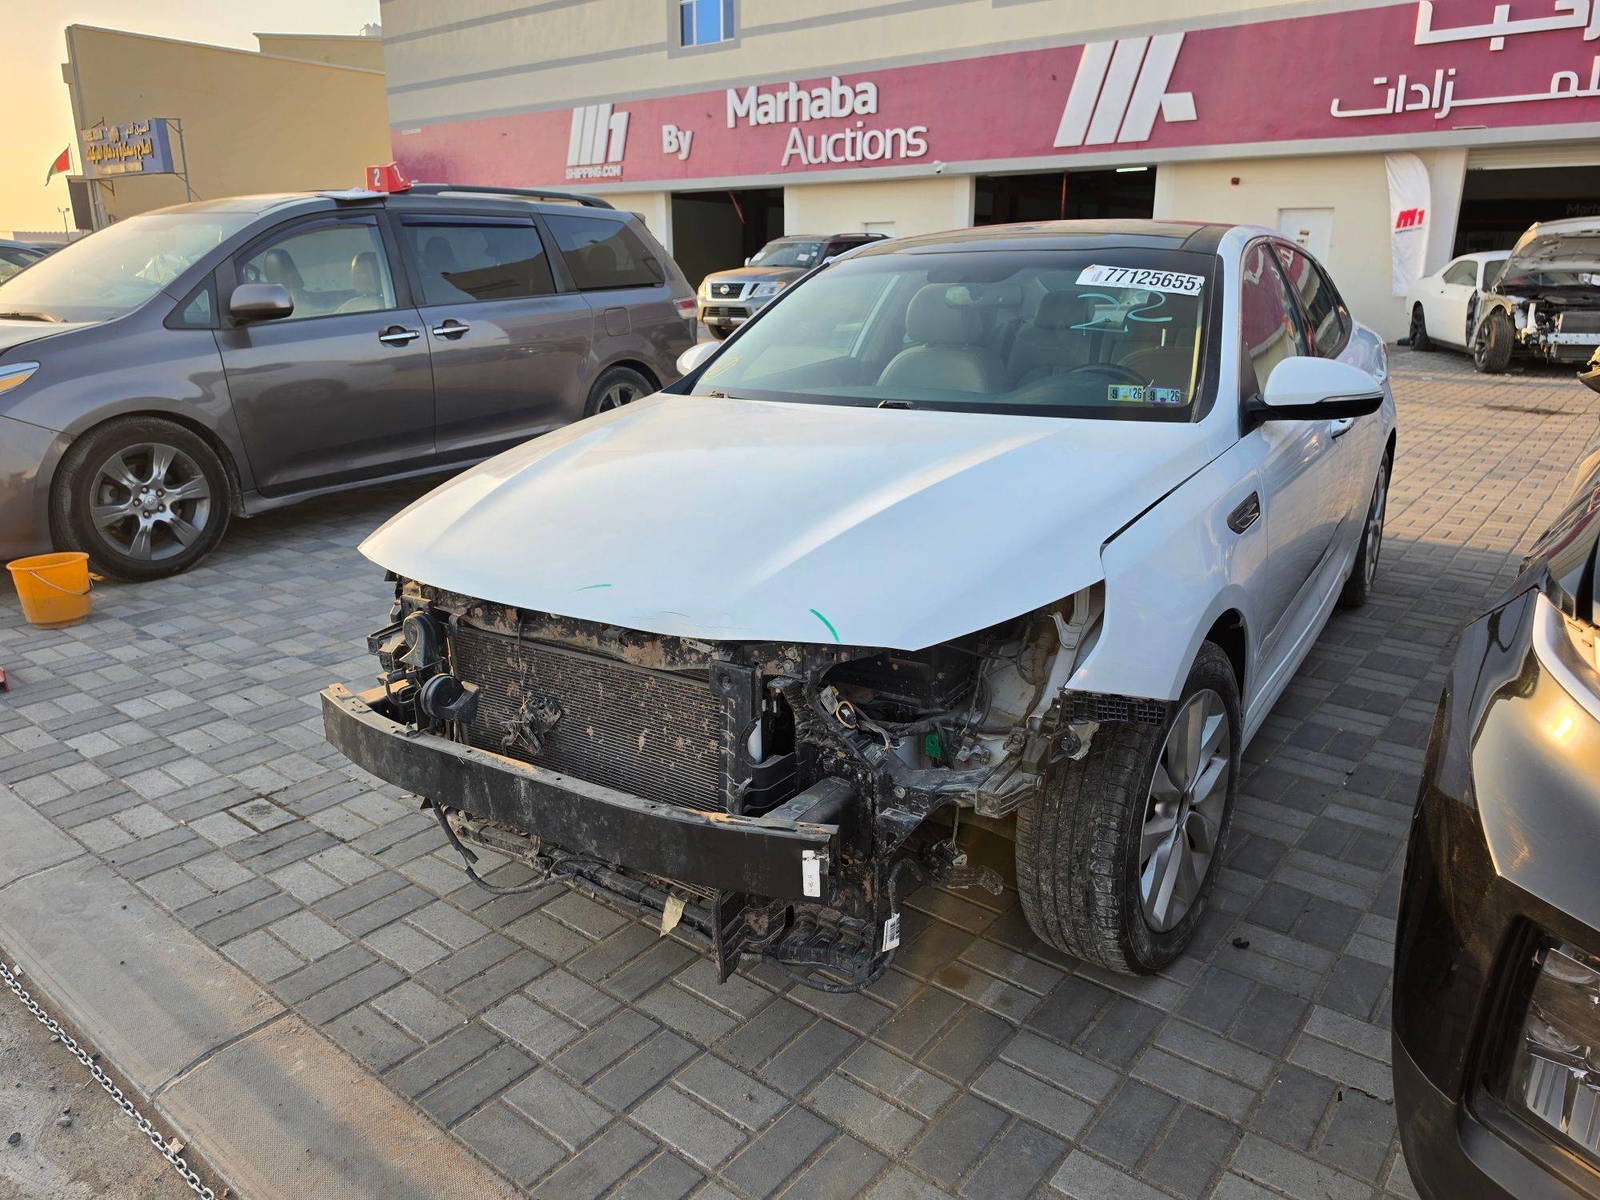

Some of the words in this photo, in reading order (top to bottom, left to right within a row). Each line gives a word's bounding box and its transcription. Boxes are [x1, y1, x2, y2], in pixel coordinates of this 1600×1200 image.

[726, 76, 878, 129] Marhaba
[661, 124, 694, 160] By
[781, 121, 928, 166] Auctions
[373, 168, 381, 187] 2
[1133, 387, 1142, 400] 26
[1170, 391, 1180, 402] 26
